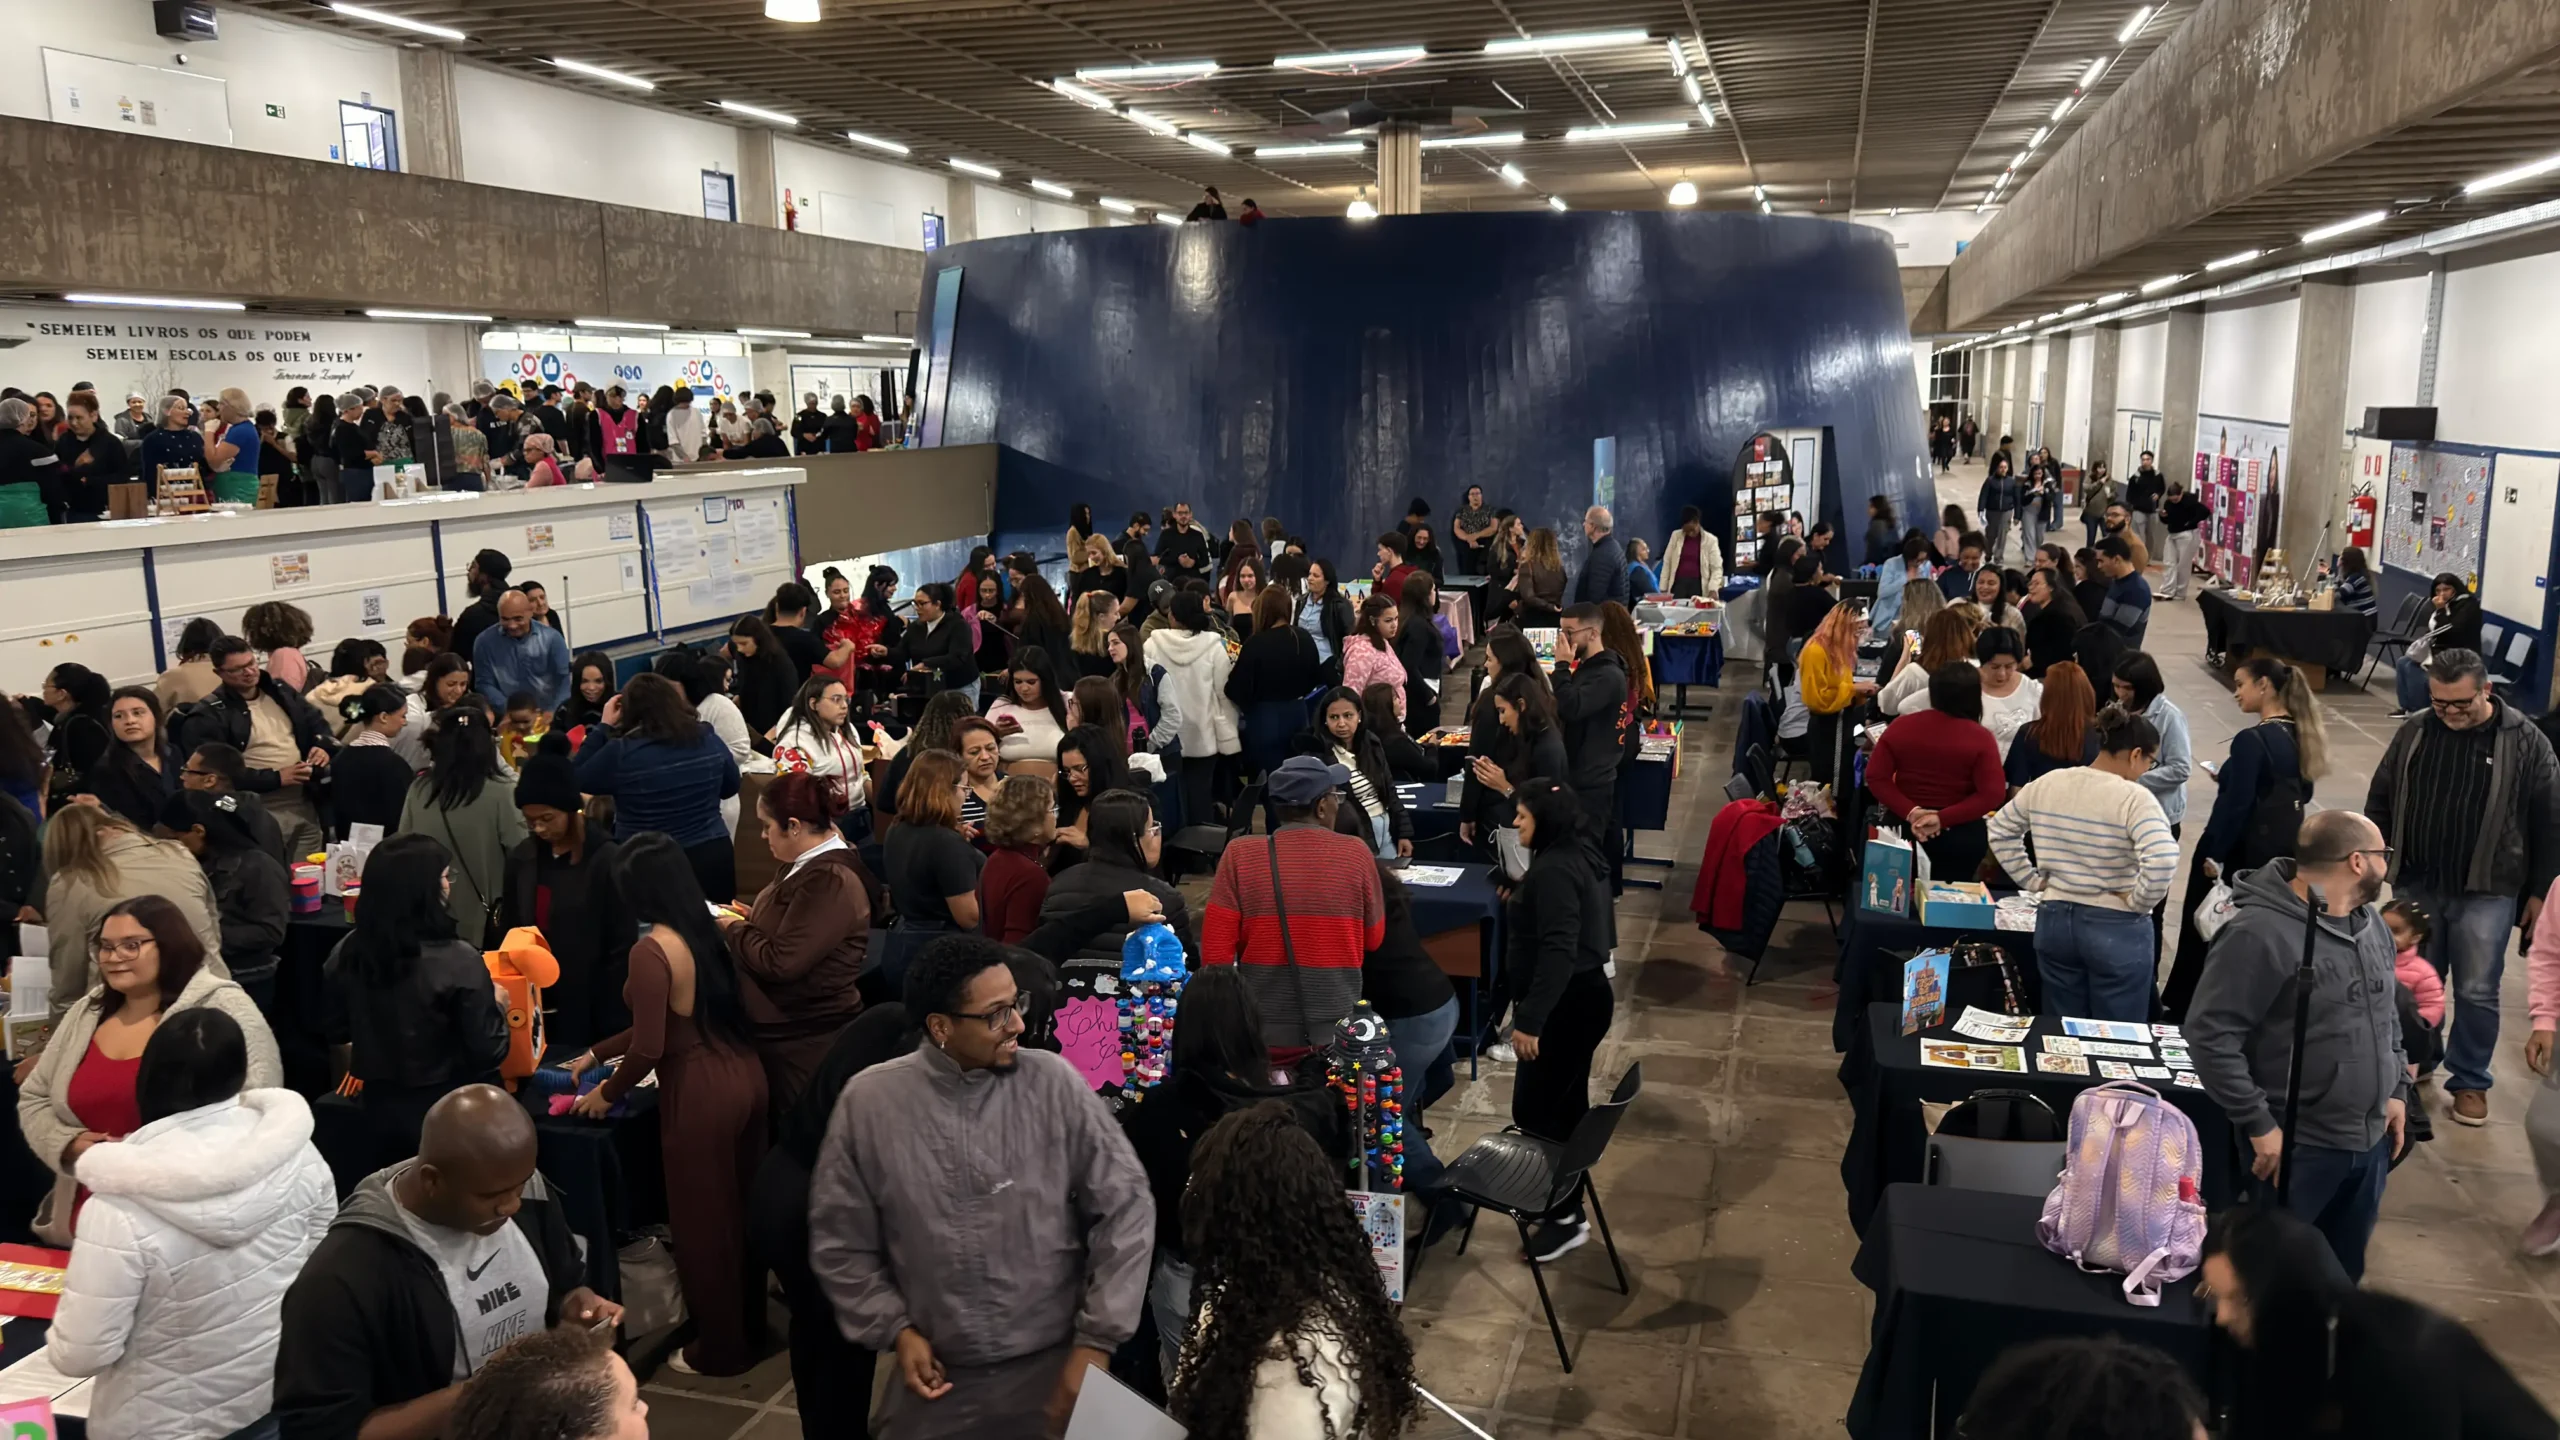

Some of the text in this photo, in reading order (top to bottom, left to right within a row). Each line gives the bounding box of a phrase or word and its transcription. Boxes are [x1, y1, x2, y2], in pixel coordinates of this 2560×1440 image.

[127, 325, 189, 339] LIVROS
[198, 328, 218, 339] OS
[227, 329, 256, 341] QUE
[265, 330, 312, 342] PODEM
[86, 348, 158, 361] SEMEIEM
[169, 349, 237, 361] ESCOLAS
[246, 351, 265, 362] OS
[273, 351, 301, 363] QUE
[476, 1281, 521, 1316] NIKE
[481, 1309, 527, 1357] NIKE
